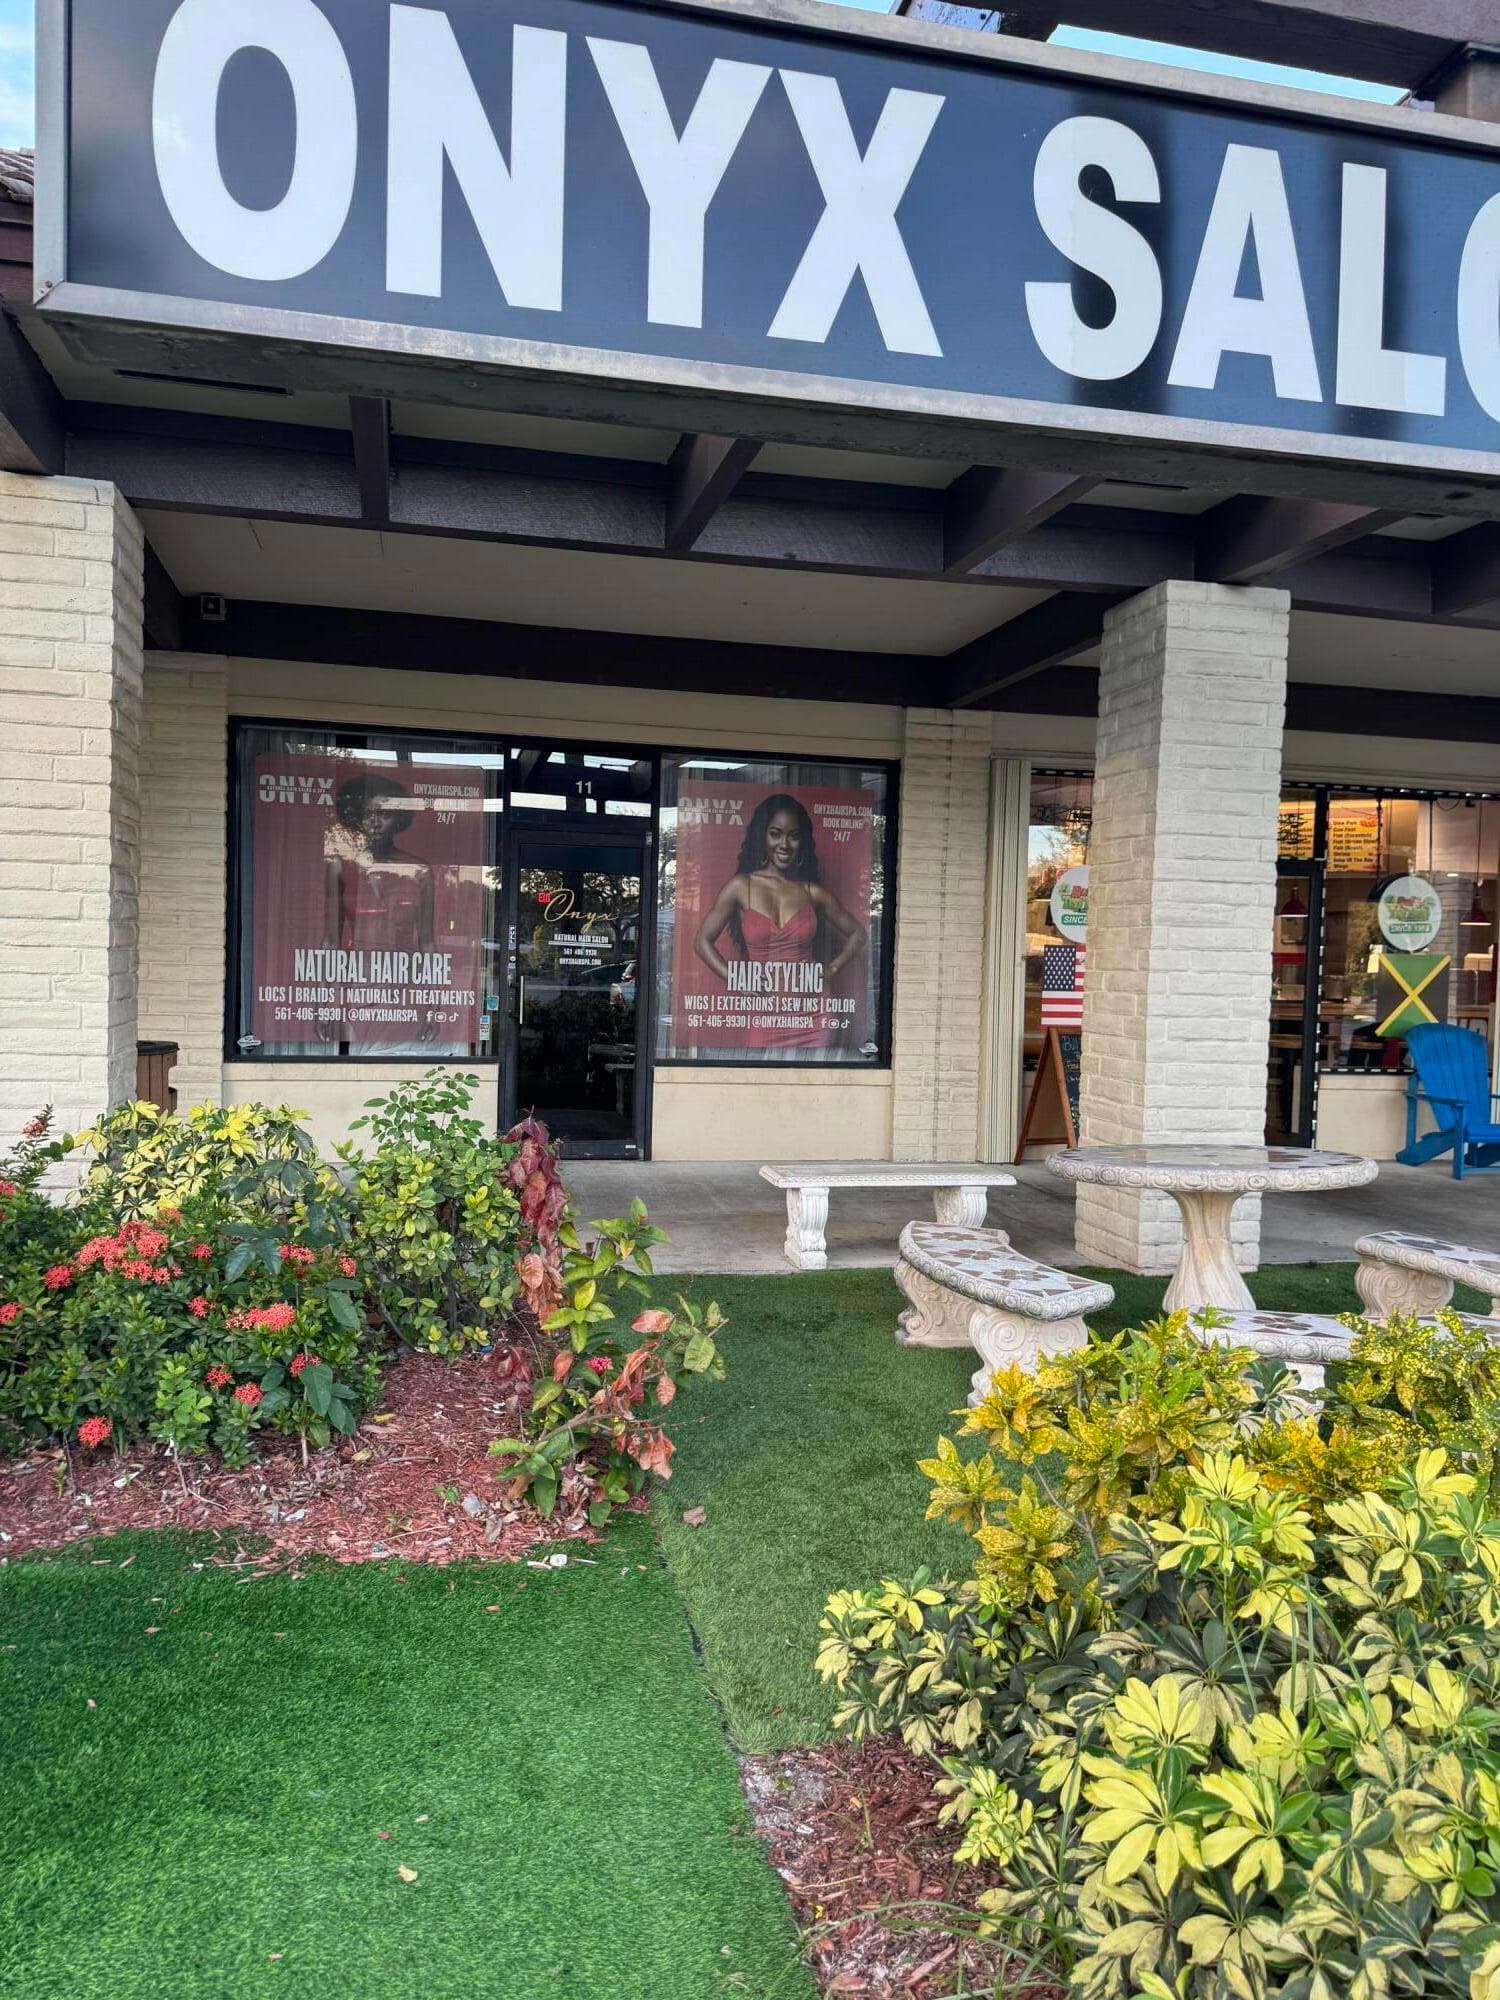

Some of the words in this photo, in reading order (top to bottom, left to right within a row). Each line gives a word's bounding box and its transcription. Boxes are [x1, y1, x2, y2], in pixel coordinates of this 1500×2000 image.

[152, 0, 945, 357] ONYX
[260, 775, 334, 805] ONYX
[576, 780, 592, 794] 11
[437, 812, 456, 825] 24/7
[679, 797, 744, 825] ONYX
[833, 831, 850, 842] 24/7
[544, 888, 620, 933] Onyx
[295, 949, 367, 983] NATURAL
[370, 951, 409, 985] HAIR
[412, 952, 453, 985] CARE
[727, 960, 762, 991] HAIR
[764, 962, 824, 993] STYLING
[259, 986, 286, 1003] LOCS
[296, 987, 335, 1003] BRAIDS
[347, 989, 400, 1005] NATURALS
[409, 990, 475, 1006] TREATMENTS
[684, 995, 709, 1010] WIGS
[717, 996, 773, 1011] EXTENSIONS
[781, 997, 801, 1012] SEW
[802, 998, 818, 1012] INS
[826, 999, 856, 1013] COLOR
[274, 1006, 341, 1022] 561-406-9930
[348, 1008, 418, 1022] @ONYXHAIRSPA
[688, 1014, 746, 1028] 561-406-9930
[752, 1015, 814, 1029] @ONYXHAIRSPA
